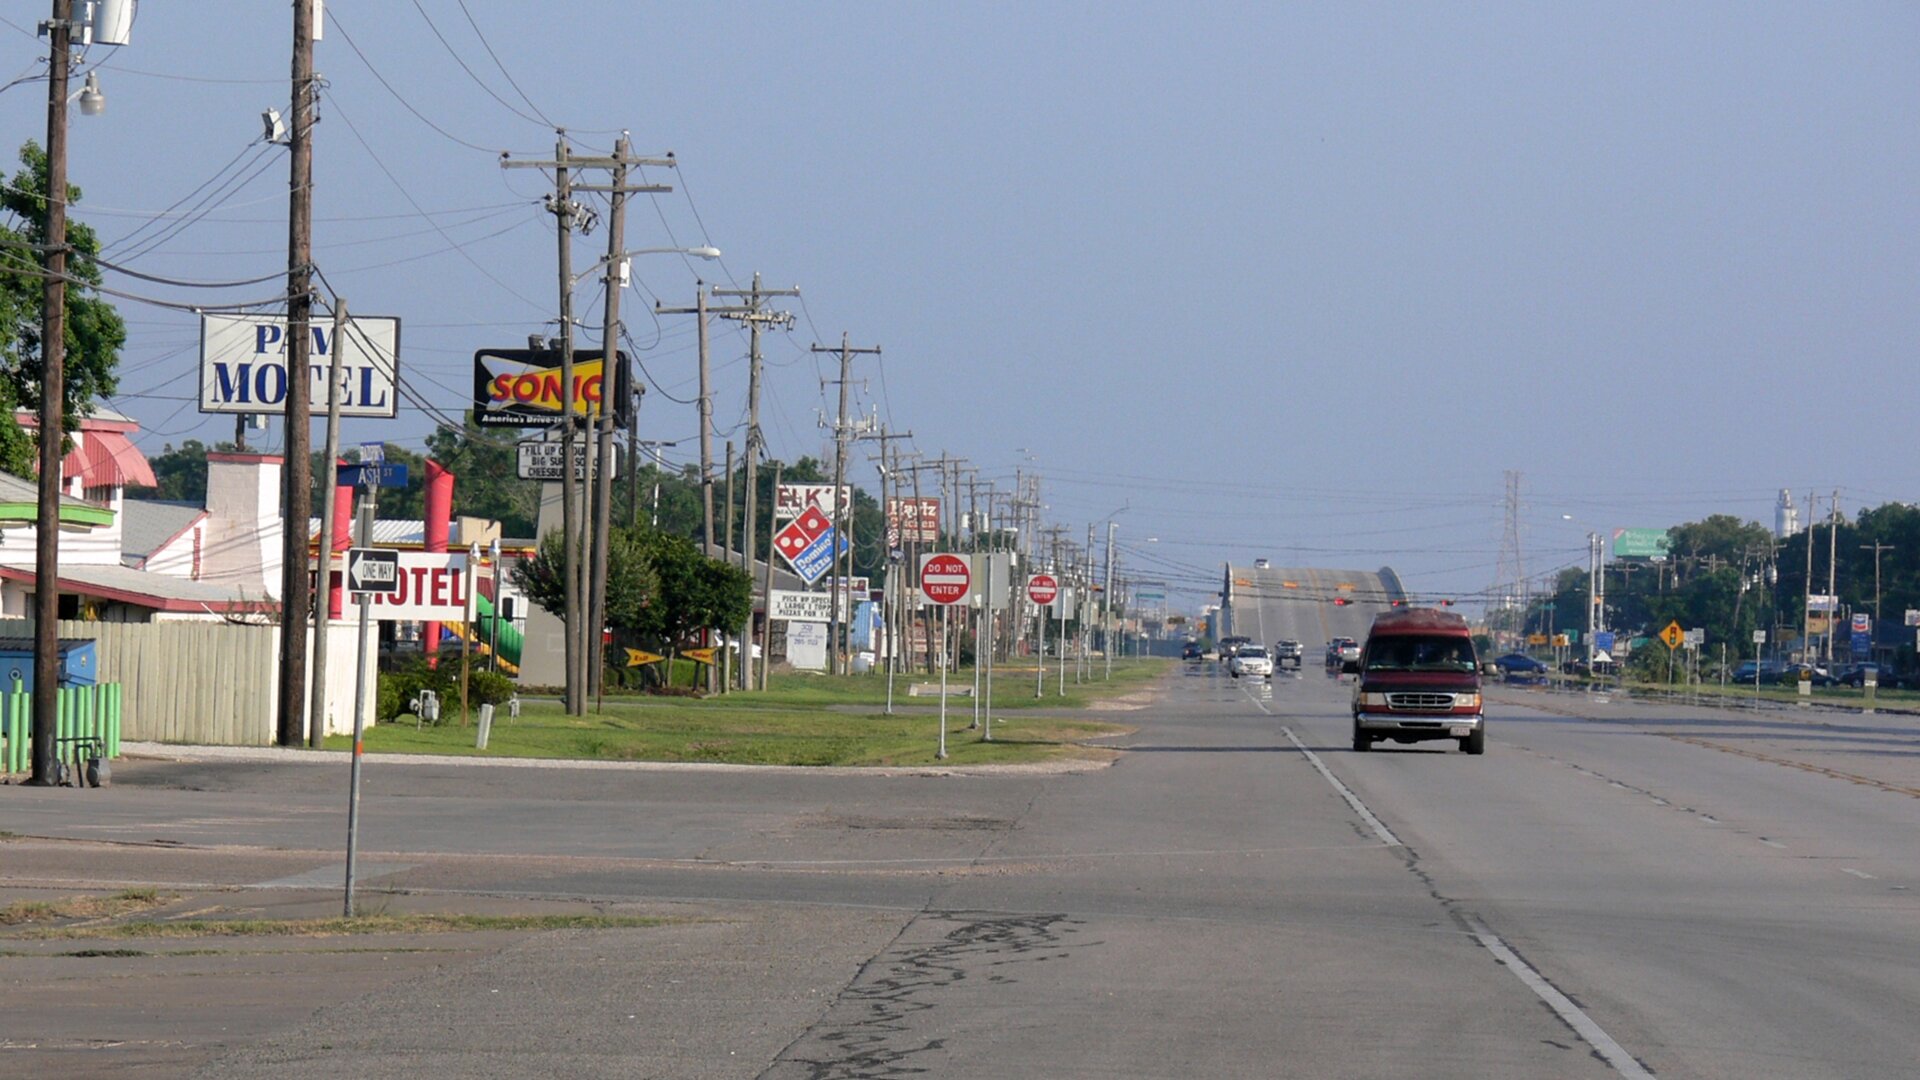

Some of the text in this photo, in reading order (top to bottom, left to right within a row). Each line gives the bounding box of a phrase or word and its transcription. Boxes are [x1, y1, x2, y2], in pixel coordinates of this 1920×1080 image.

[254, 325, 334, 355] PM
[492, 373, 603, 402] SONIC
[482, 414, 524, 423] America's
[358, 467, 381, 485] ASH
[362, 562, 394, 580] ONE WAY
[928, 564, 963, 573] DO NOT
[351, 567, 466, 607] OTEL
[931, 586, 959, 594] ENTER
[811, 596, 831, 604] SPECI
